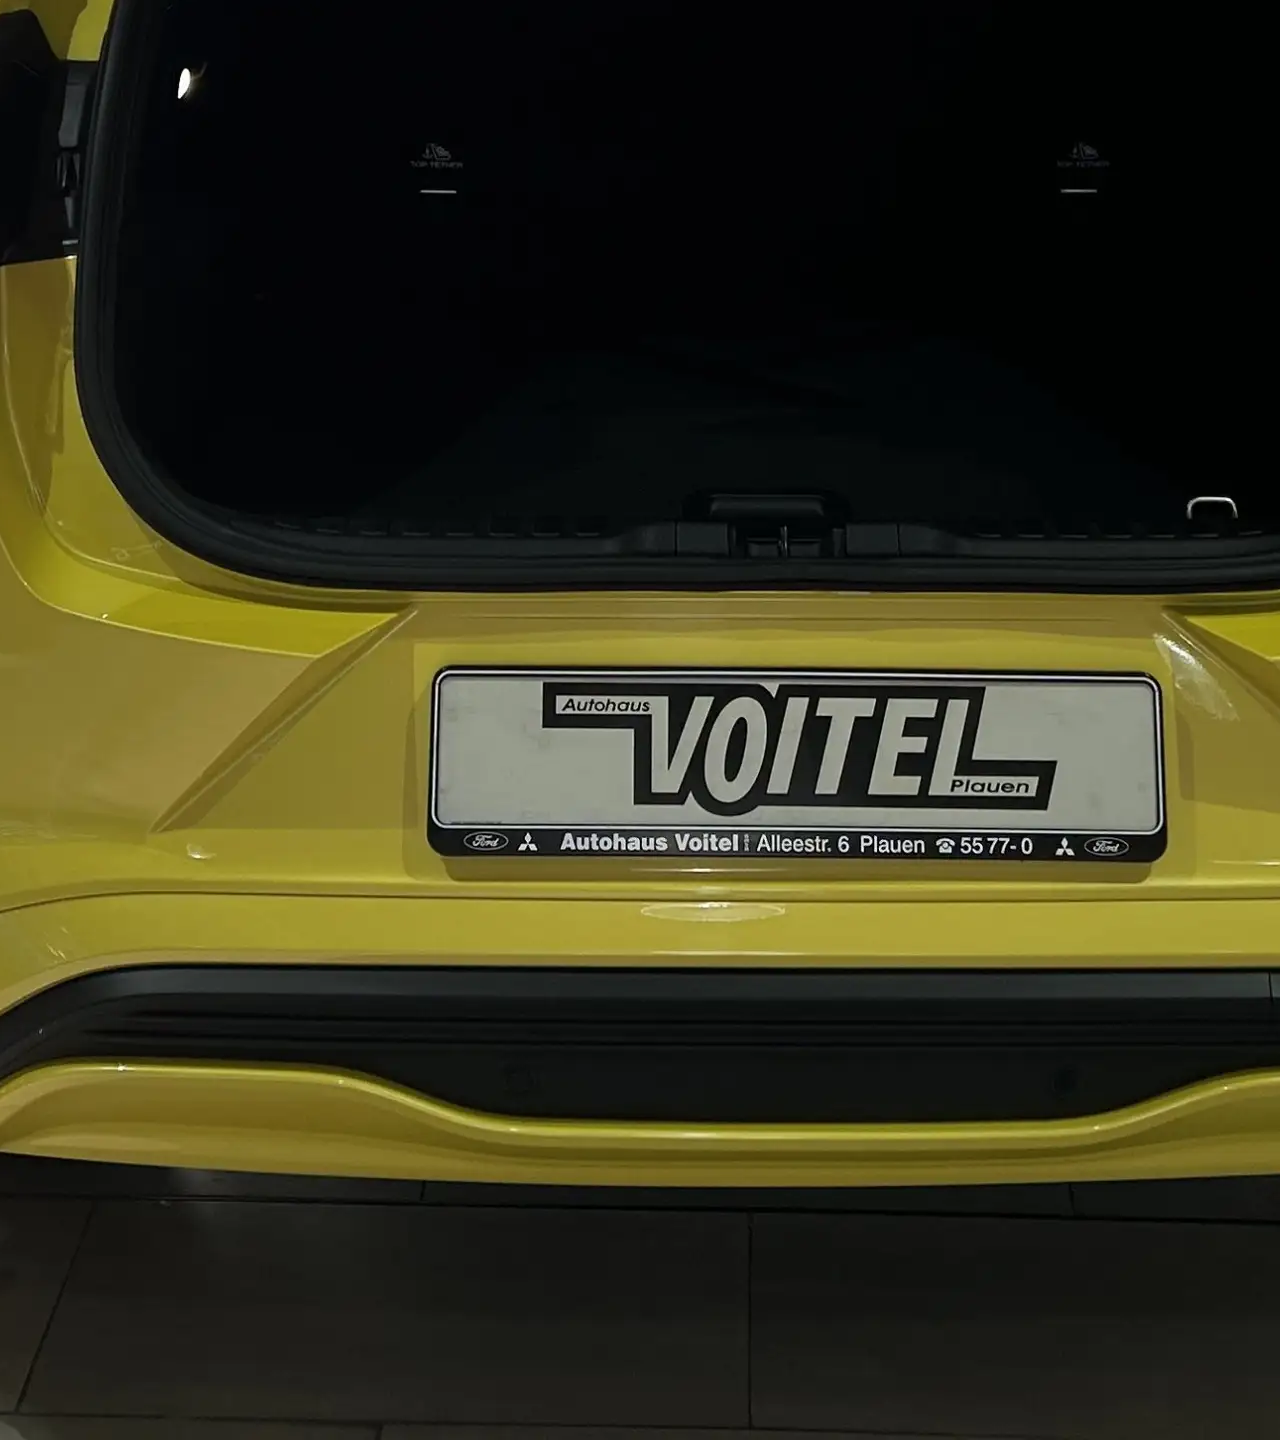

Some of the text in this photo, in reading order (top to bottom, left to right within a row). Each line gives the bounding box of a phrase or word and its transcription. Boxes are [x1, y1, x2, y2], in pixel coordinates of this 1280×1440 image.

[561, 697, 651, 714] Autohaus
[648, 691, 998, 807] VOITEL
[949, 777, 1031, 795] Plauen
[560, 832, 668, 852] Autohaus
[674, 832, 739, 852] Voitel
[756, 834, 832, 853] Alleestr.
[837, 836, 850, 854] 6
[860, 836, 926, 854] Plauen
